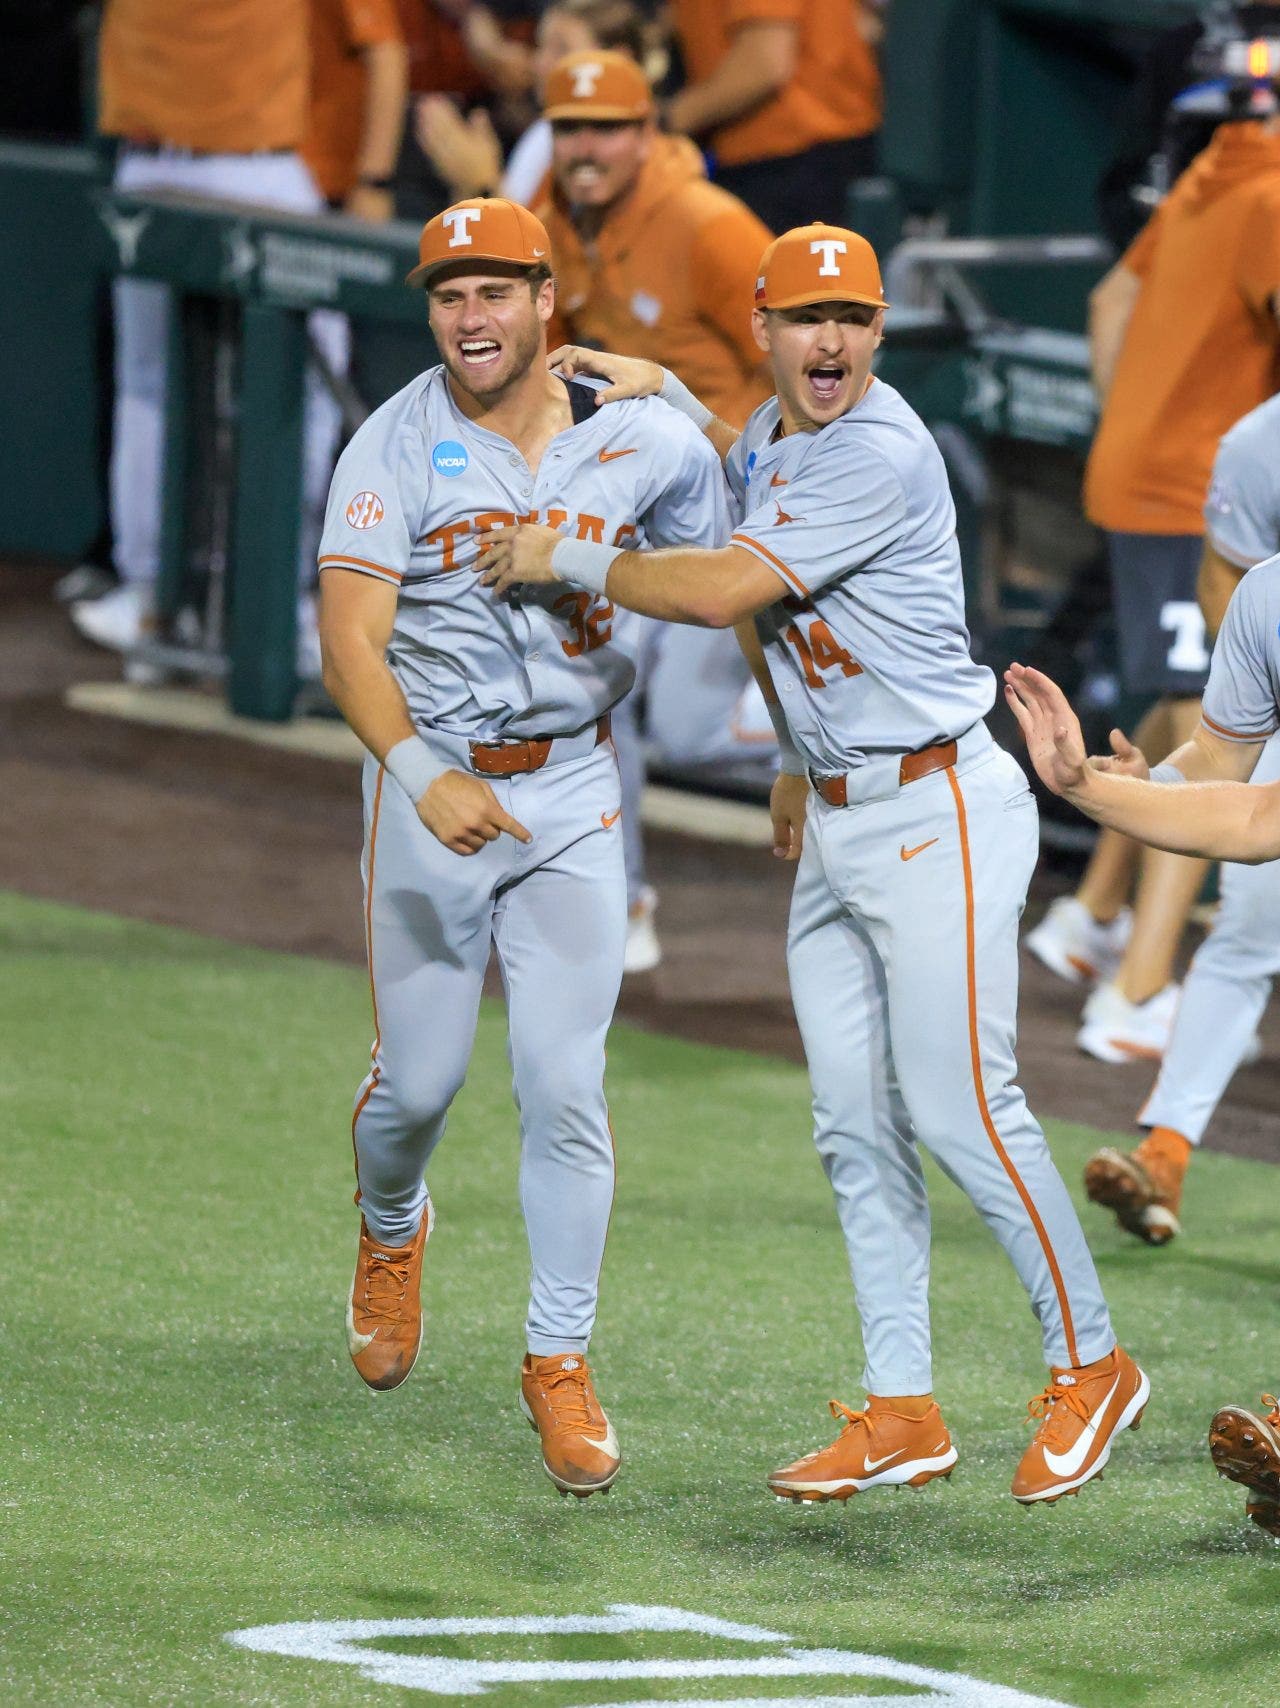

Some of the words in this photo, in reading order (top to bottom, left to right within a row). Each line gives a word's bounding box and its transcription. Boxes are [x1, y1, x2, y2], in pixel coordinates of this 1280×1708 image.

[570, 63, 604, 97] T
[443, 208, 481, 247] T
[810, 240, 848, 277] T
[436, 457, 466, 468] NCAA
[346, 491, 384, 529] SEC
[552, 591, 615, 658] 32
[786, 620, 864, 689] 14
